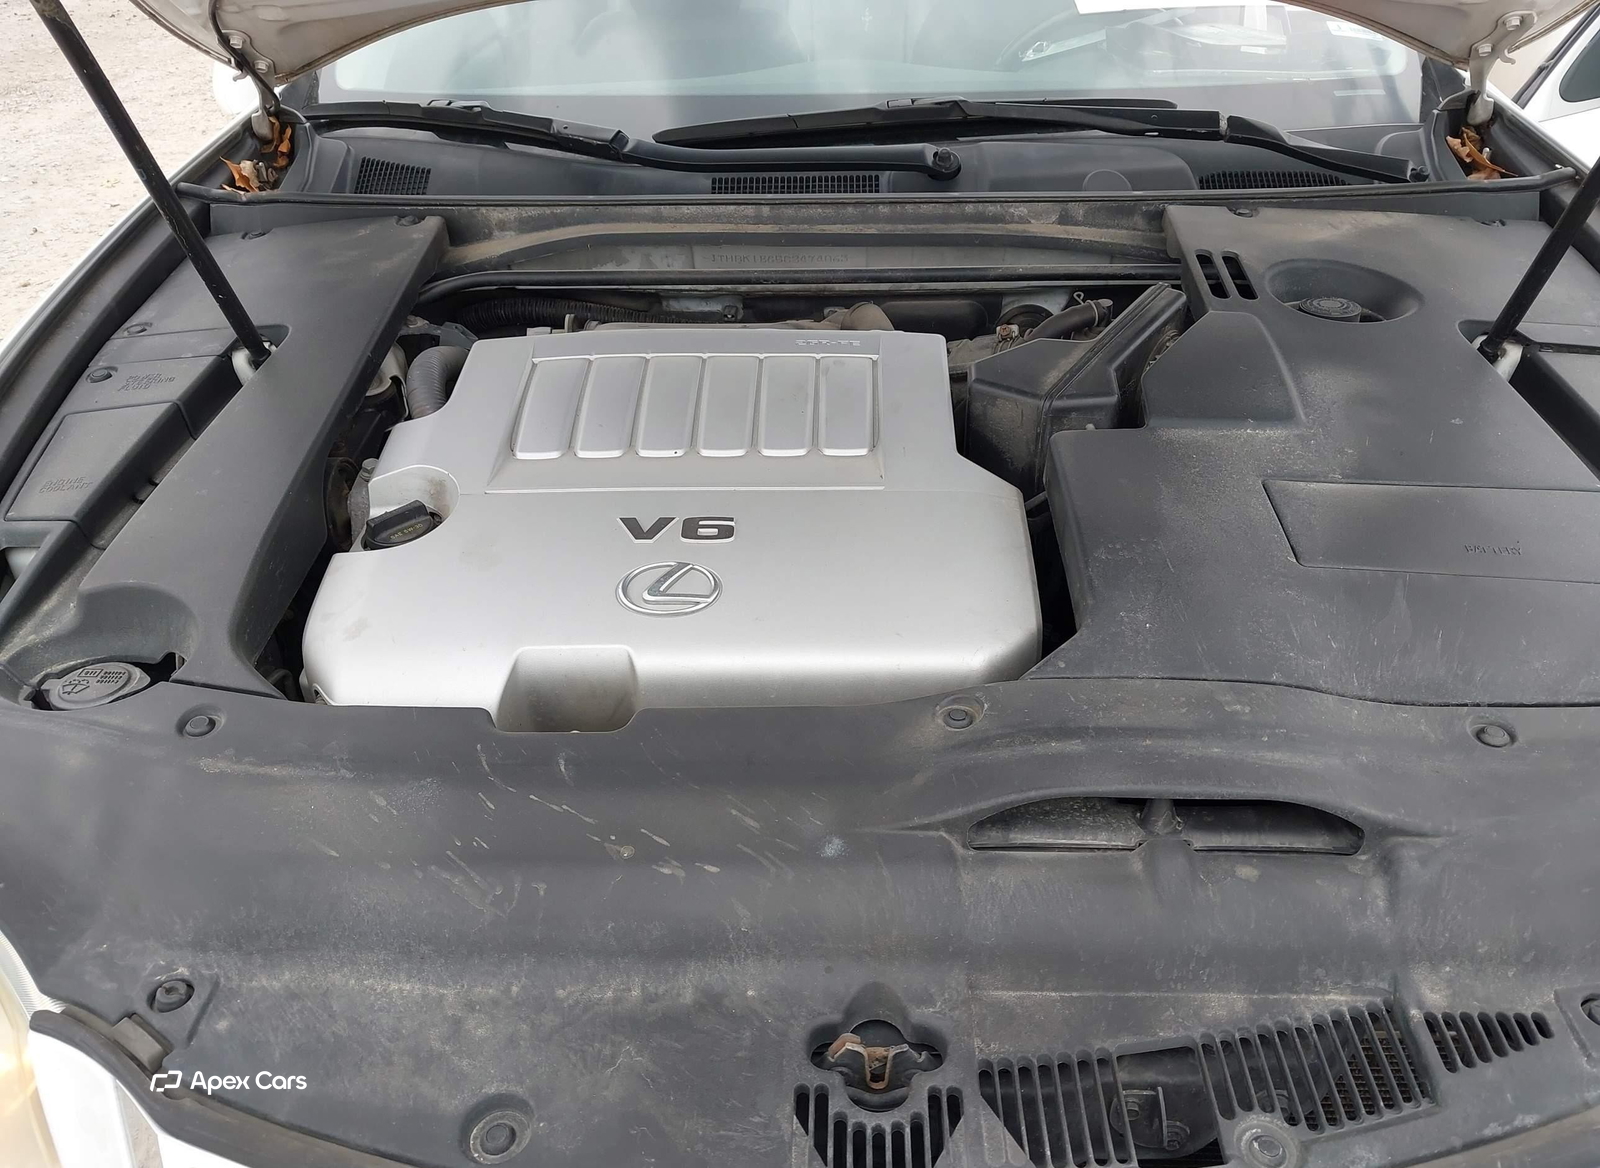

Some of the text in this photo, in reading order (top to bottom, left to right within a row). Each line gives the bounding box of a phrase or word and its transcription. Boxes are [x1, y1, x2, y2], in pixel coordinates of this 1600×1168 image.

[39, 482, 93, 493] COOLANT
[45, 476, 86, 488] ENGINE
[616, 515, 736, 544] V6
